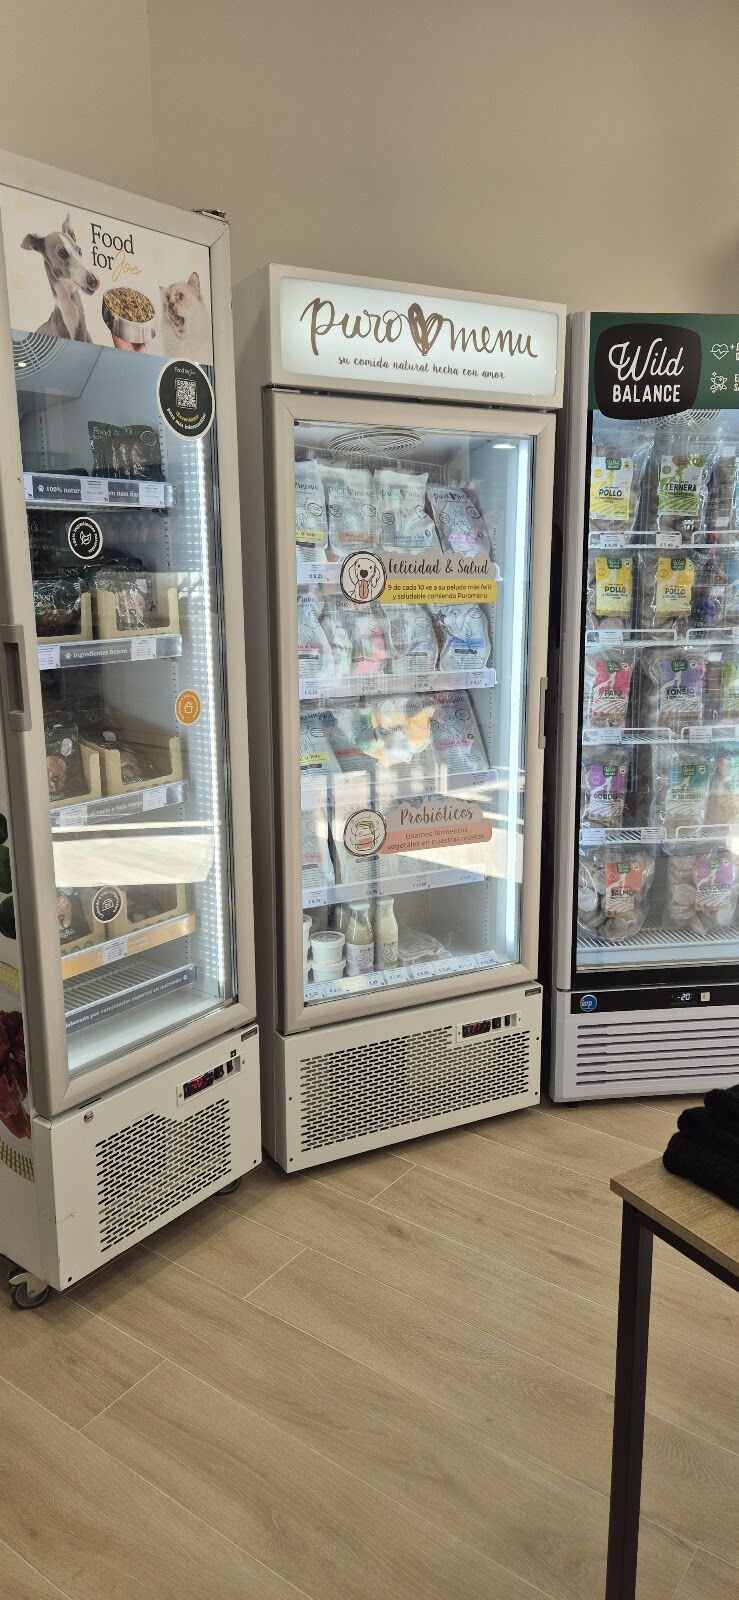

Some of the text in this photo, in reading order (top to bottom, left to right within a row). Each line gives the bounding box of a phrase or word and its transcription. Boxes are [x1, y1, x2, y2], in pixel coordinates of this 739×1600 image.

[90, 223, 134, 254] Food
[91, 246, 142, 281] for Joe
[450, 318, 538, 358] menu
[338, 356, 505, 379] su comida natural hecha con amor
[608, 338, 684, 381] Wild
[612, 385, 680, 403] BALANCE
[599, 489, 622, 497] POLLO
[389, 558, 490, 575] Felicidad & Salud
[397, 592, 426, 600] saludable
[427, 592, 457, 600] comiendo
[457, 592, 488, 600] Puromenu
[447, 584, 467, 593] peludo
[400, 805, 473, 826] Probióticos
[387, 841, 420, 851] vegetales
[431, 836, 460, 845] nuestras
[405, 831, 433, 840] Usamos
[65, 1015, 90, 1028] laborada
